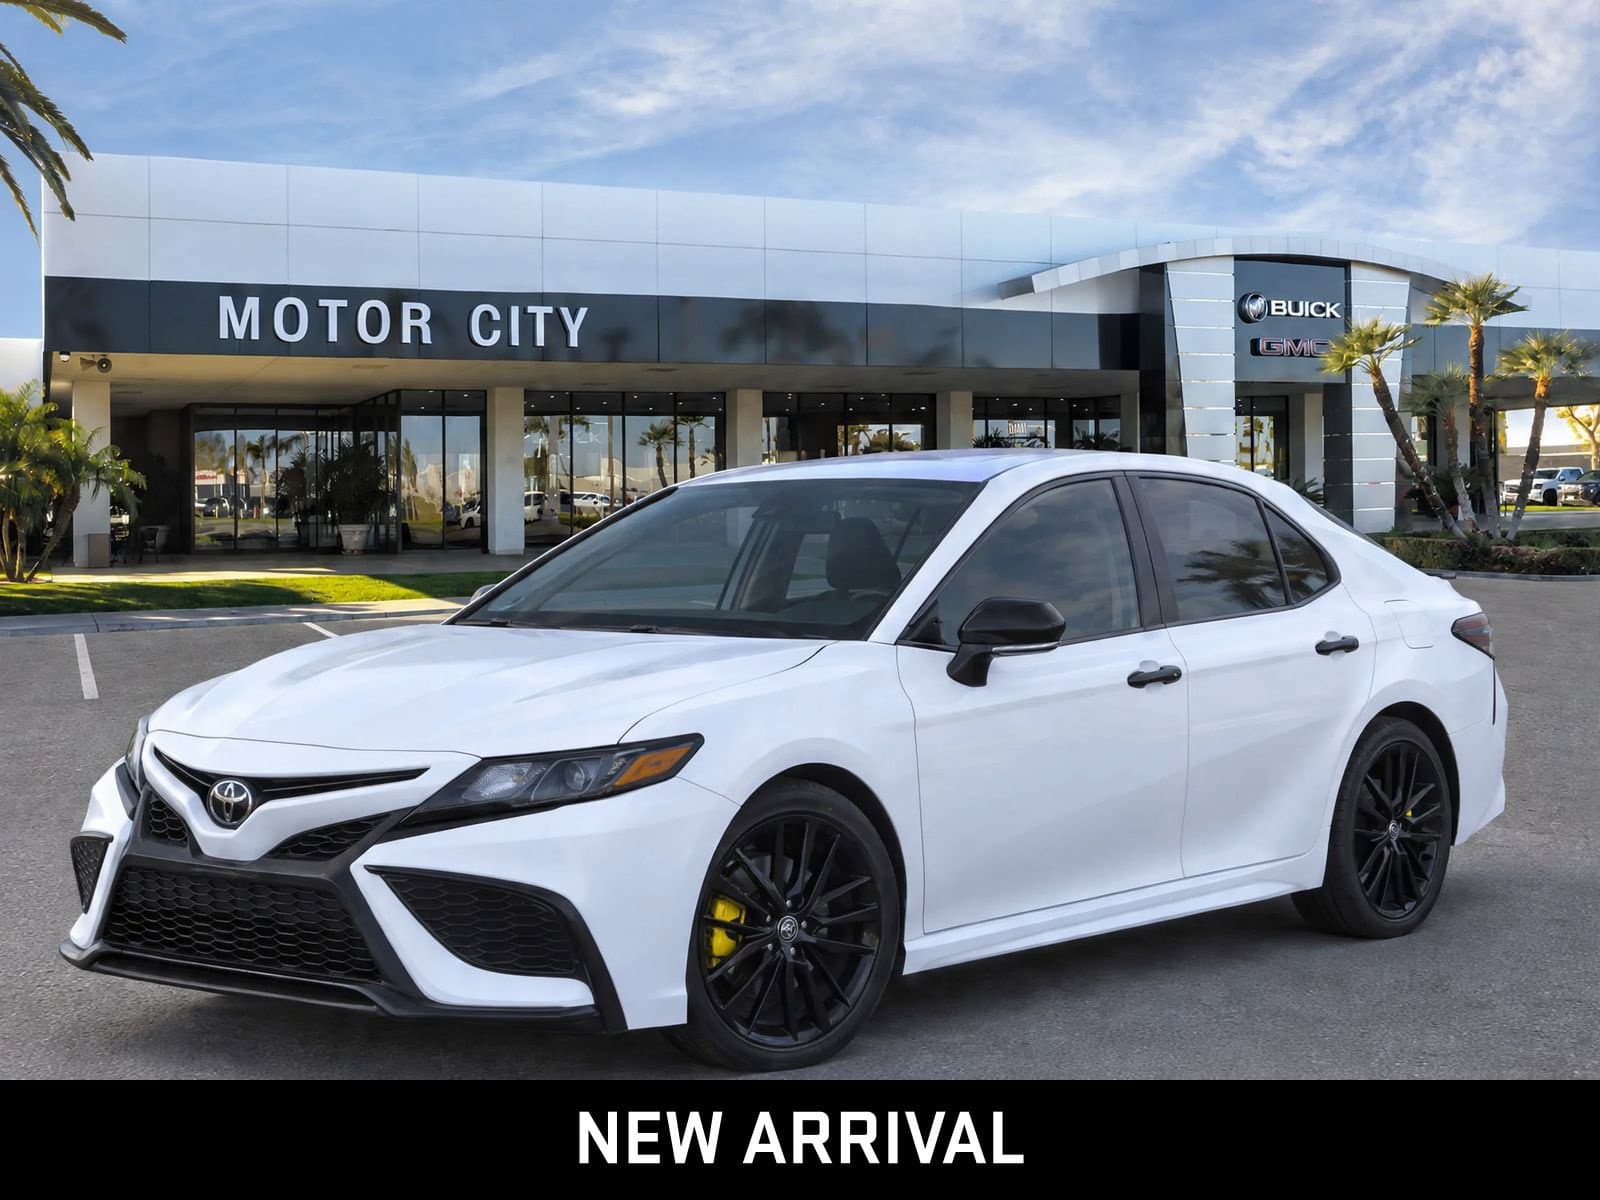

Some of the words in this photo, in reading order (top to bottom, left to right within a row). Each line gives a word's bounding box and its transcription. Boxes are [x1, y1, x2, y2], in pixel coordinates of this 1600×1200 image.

[1270, 300, 1341, 318] BUICK
[218, 296, 432, 345] MOTOR
[470, 303, 589, 348] CITY
[1259, 337, 1329, 357] GMC
